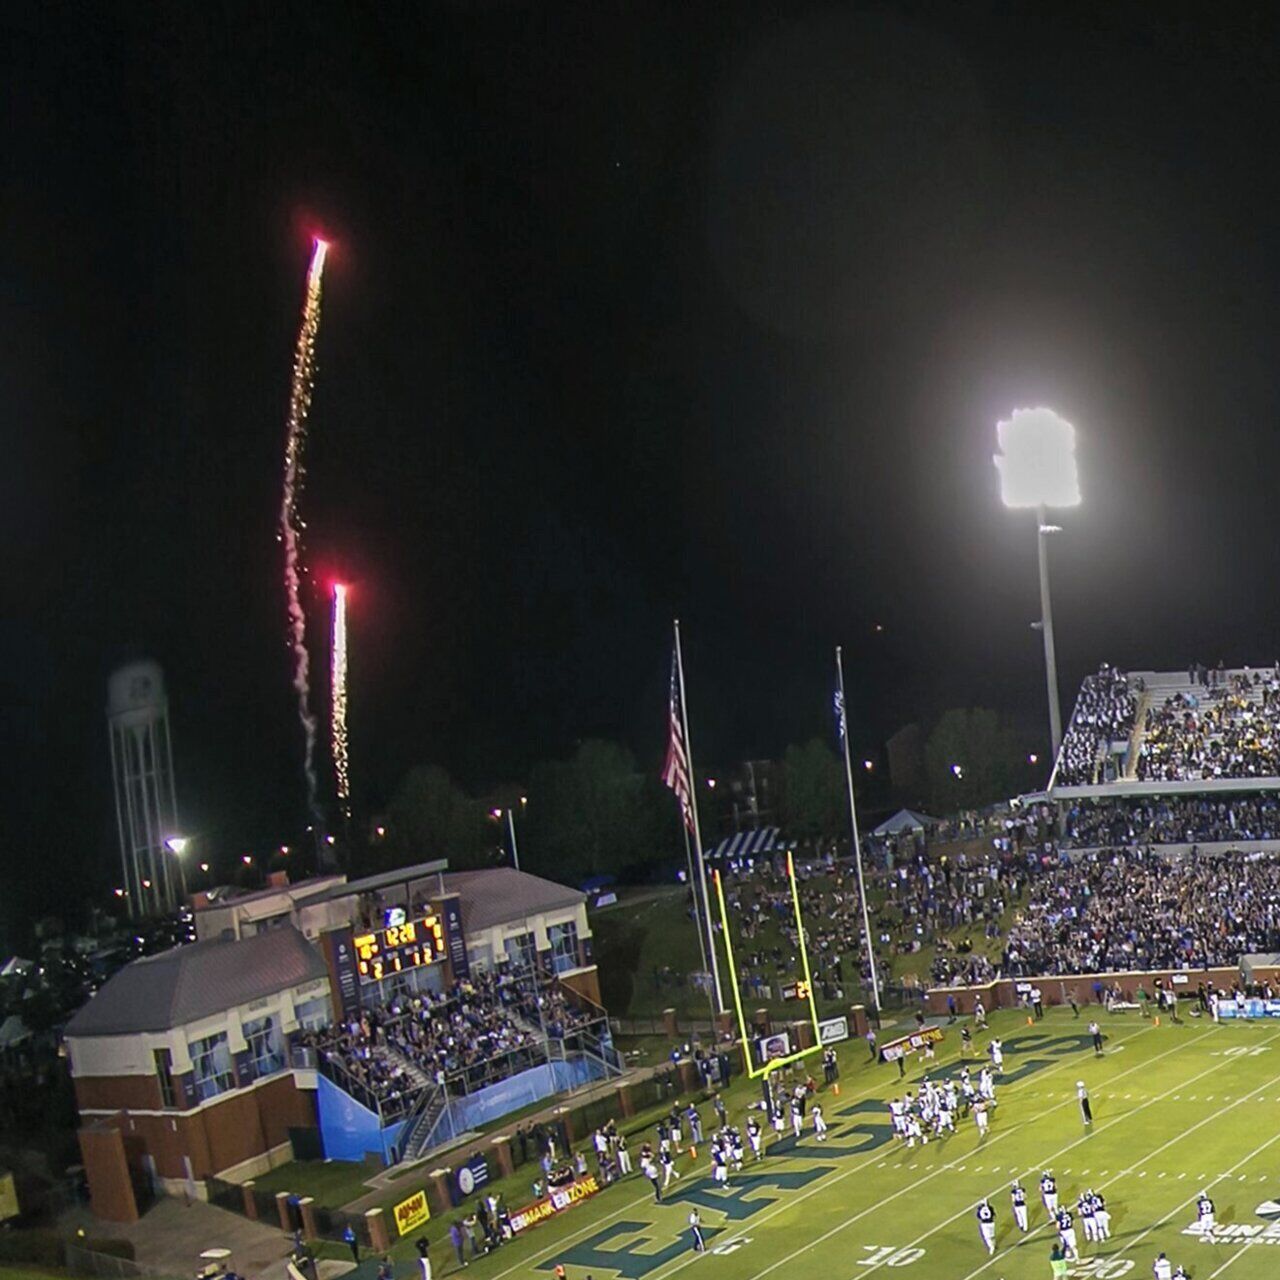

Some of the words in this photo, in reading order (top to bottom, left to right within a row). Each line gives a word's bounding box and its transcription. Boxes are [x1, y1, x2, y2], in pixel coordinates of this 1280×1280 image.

[510, 1200, 557, 1233] ENMARK
[552, 1177, 599, 1210] ENZONE
[857, 1245, 925, 1267] 10
